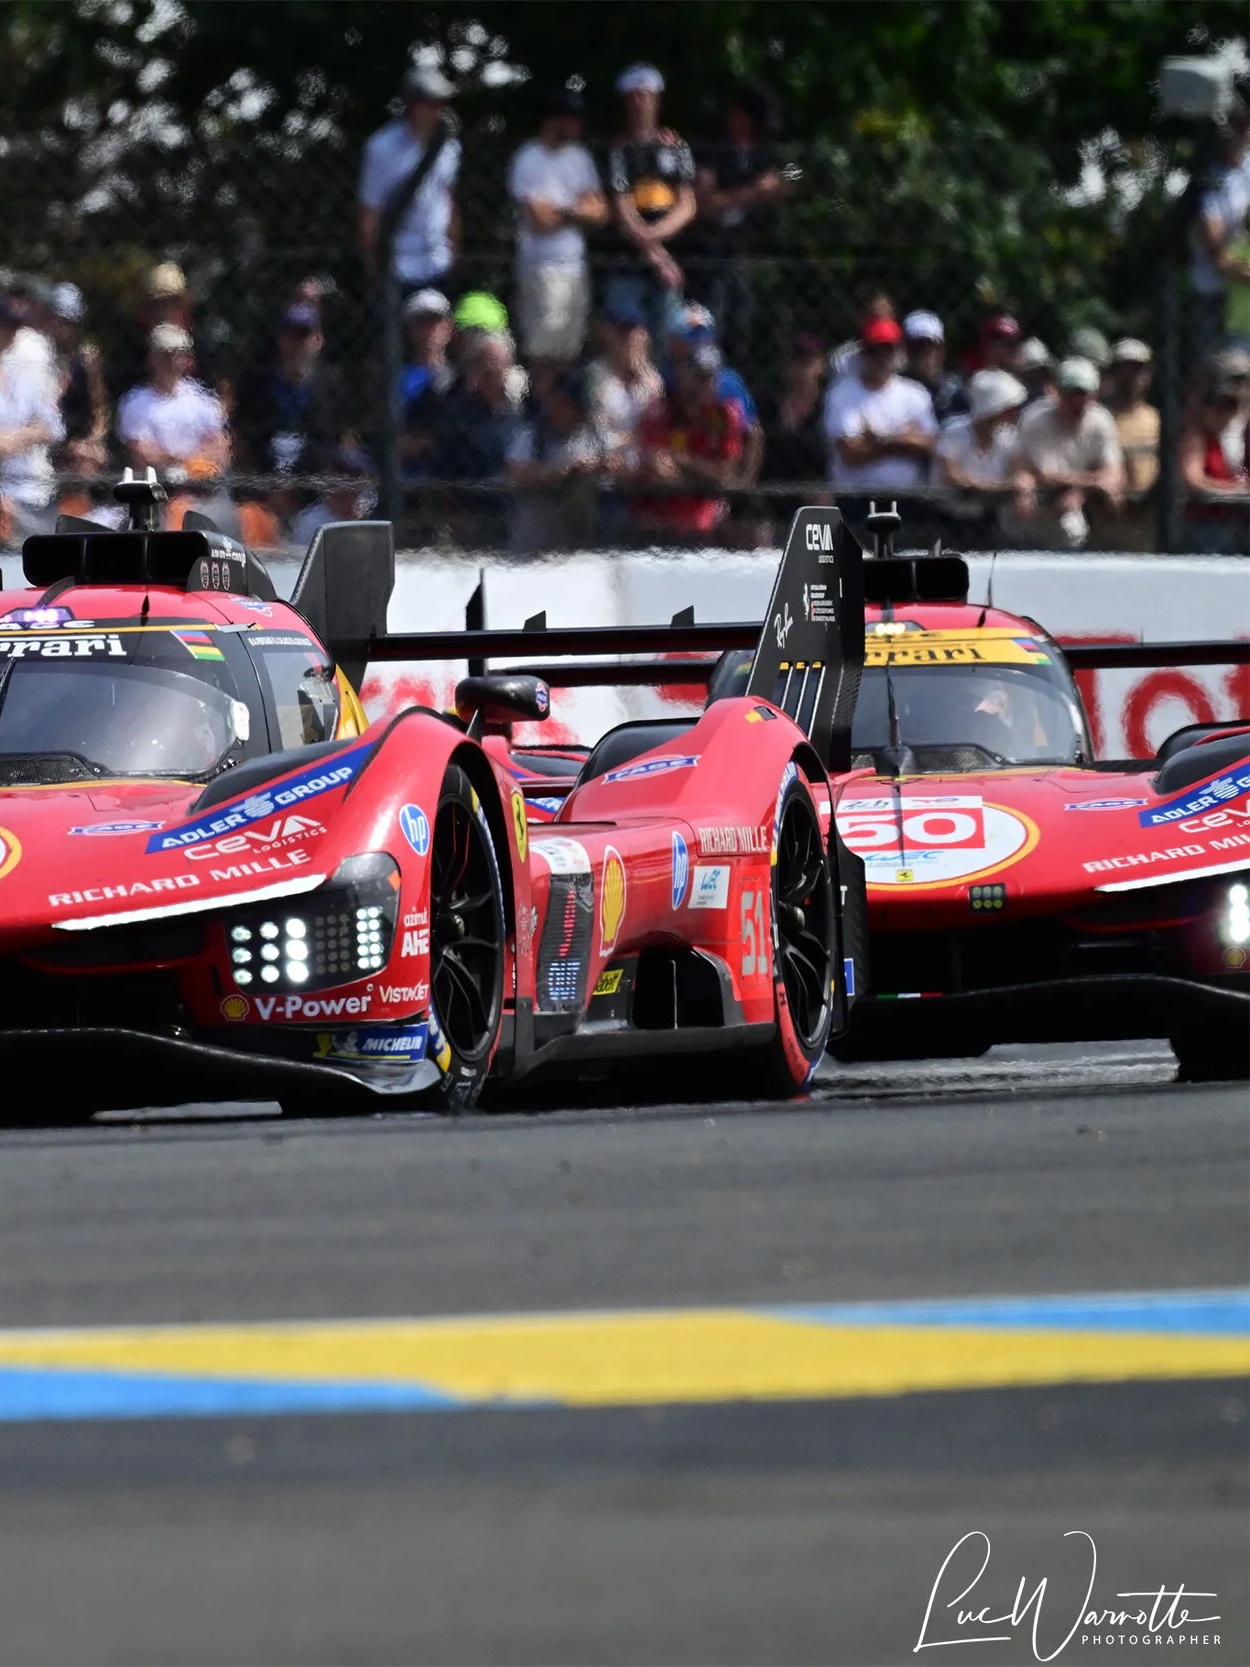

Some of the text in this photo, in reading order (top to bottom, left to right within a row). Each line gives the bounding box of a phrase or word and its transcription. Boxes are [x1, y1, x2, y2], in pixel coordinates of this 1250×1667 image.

[806, 524, 833, 550] CEVA
[162, 767, 353, 848] ADLER GROUP
[1151, 796, 1218, 824] ADLER
[184, 815, 322, 860] CEVA
[252, 827, 327, 854] LOGISTICS
[403, 805, 427, 855] hp
[698, 825, 768, 853] RICHARD MILLE
[835, 812, 976, 847] 50
[1082, 844, 1206, 873] RICHARD
[49, 848, 312, 907] RICHARD MILLE
[741, 890, 768, 976] 51
[255, 995, 371, 1020] V-Power
[362, 1035, 423, 1052] MICHELIN
